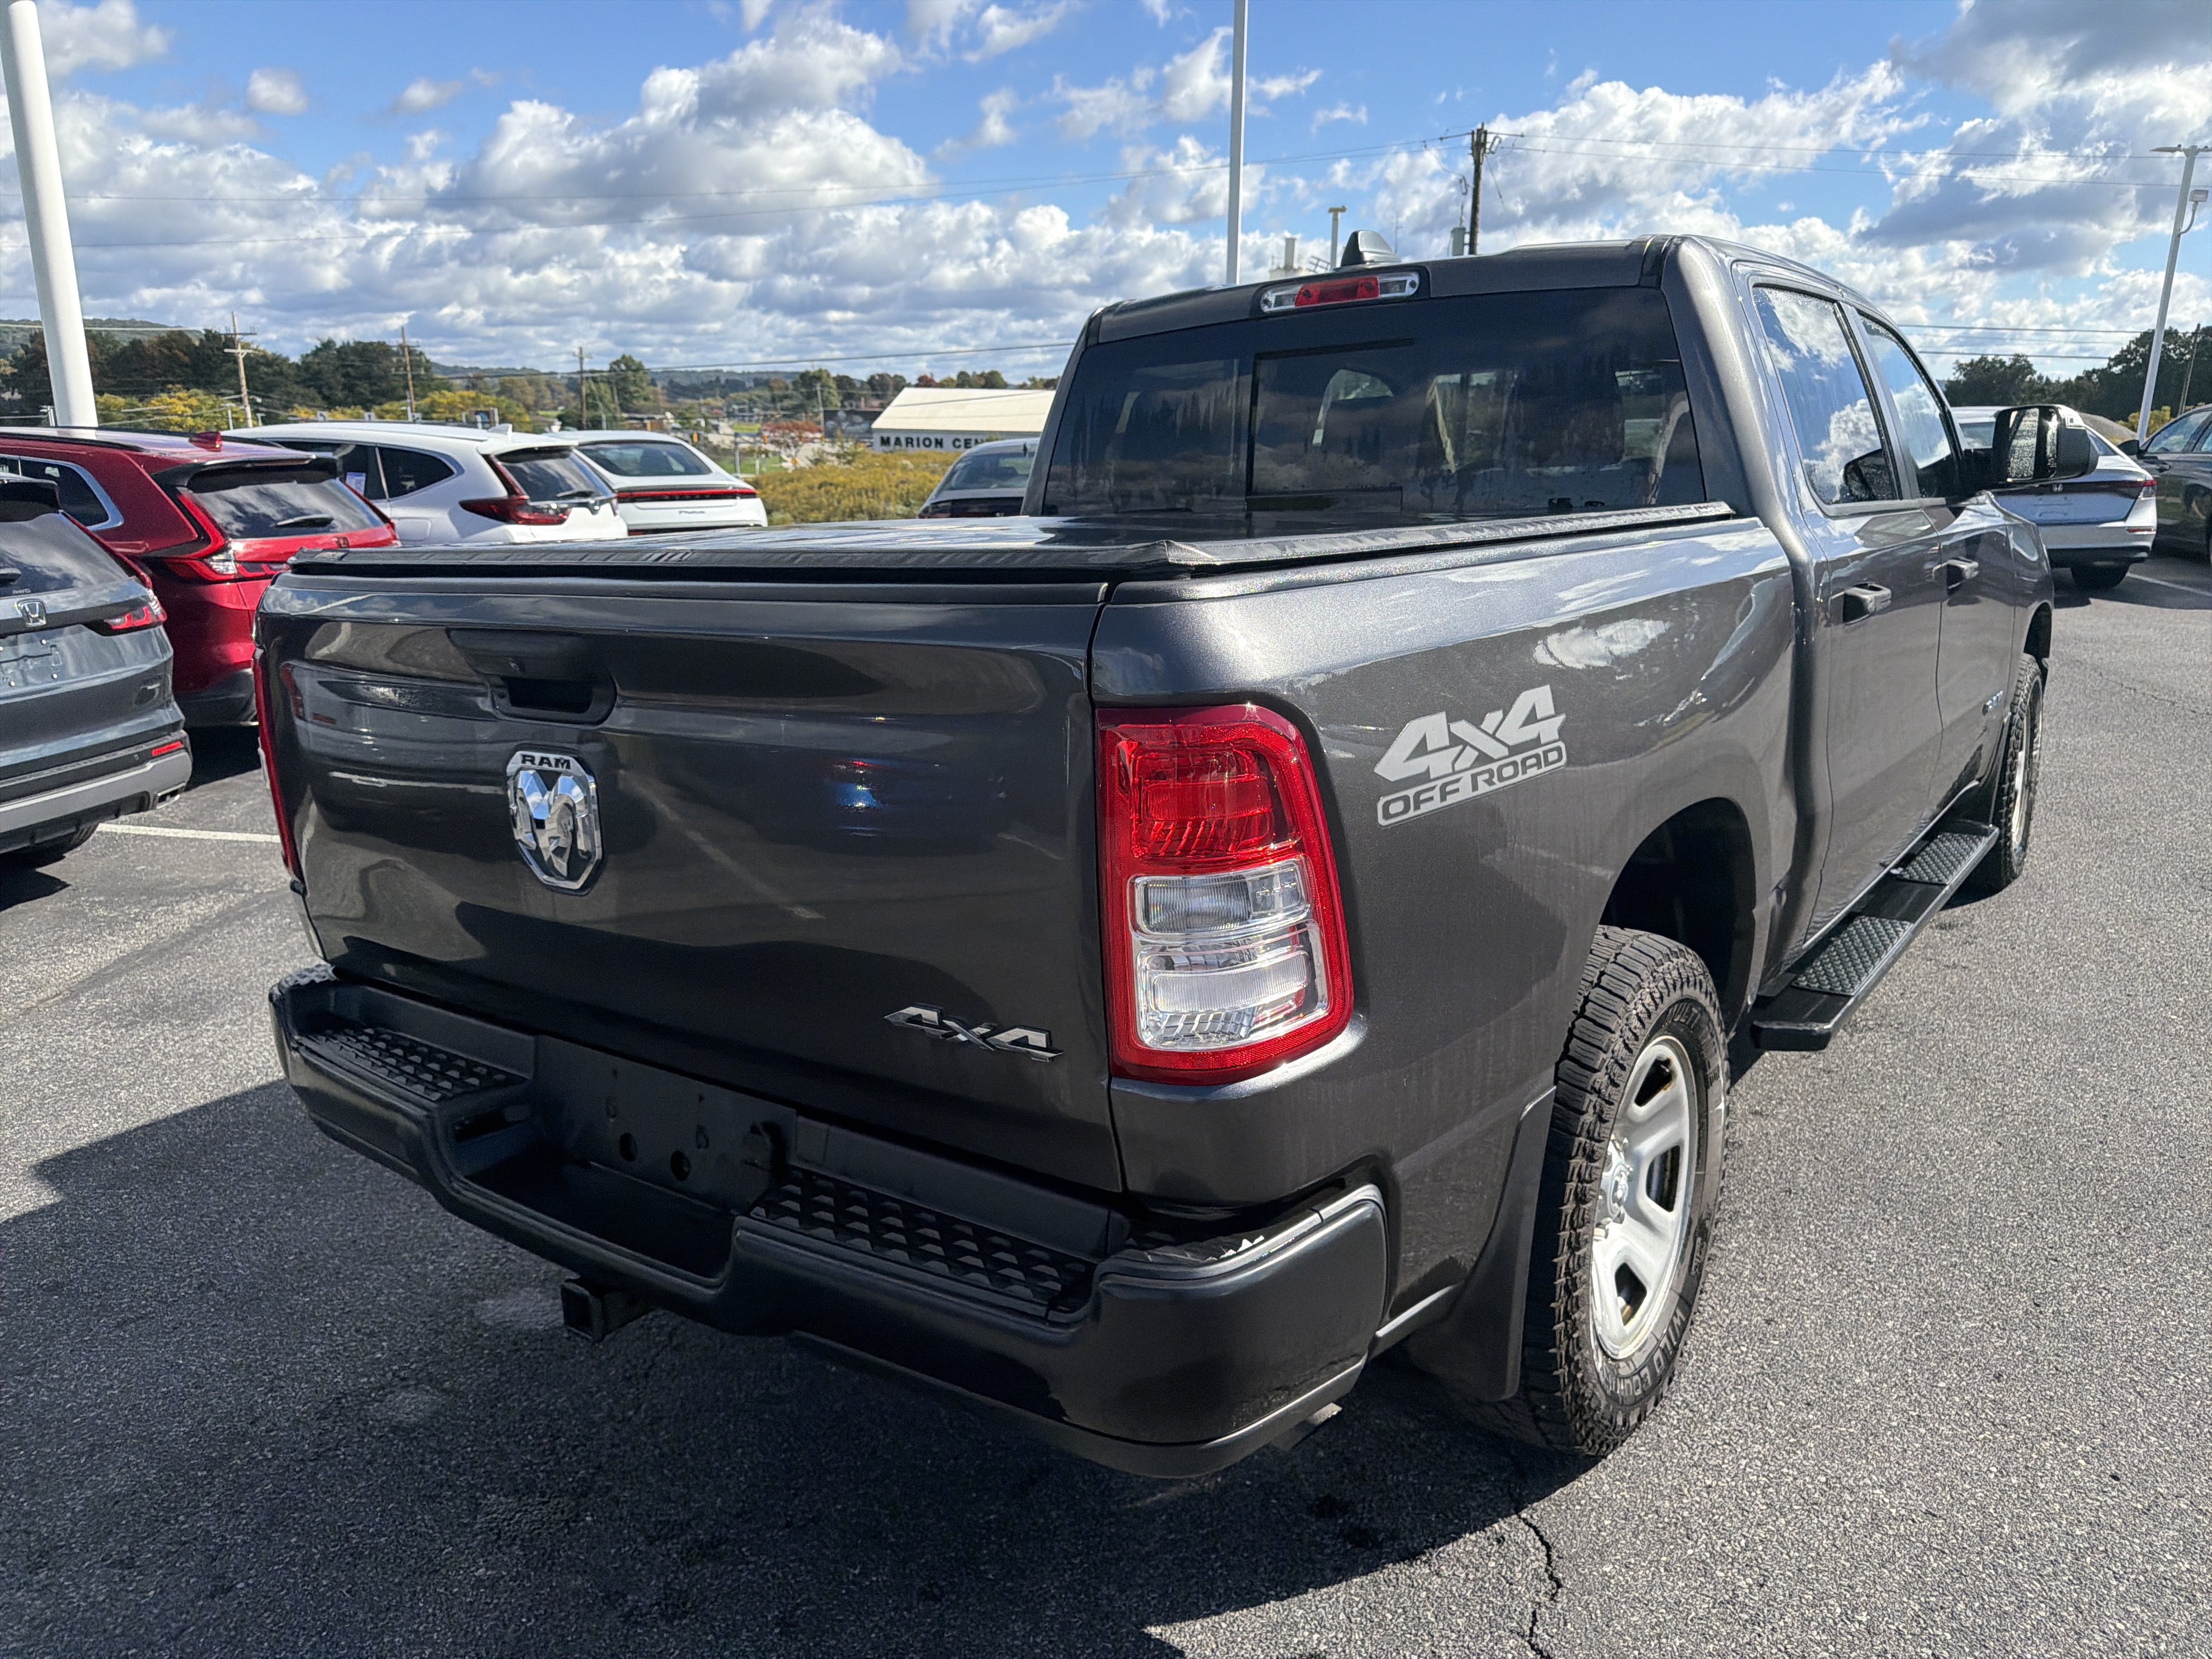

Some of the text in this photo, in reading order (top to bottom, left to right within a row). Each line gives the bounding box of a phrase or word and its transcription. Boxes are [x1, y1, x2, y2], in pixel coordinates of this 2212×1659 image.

[880, 436, 944, 449] MARION
[522, 754, 572, 770] RAM
[1382, 745, 1564, 821] OFF ROAD
